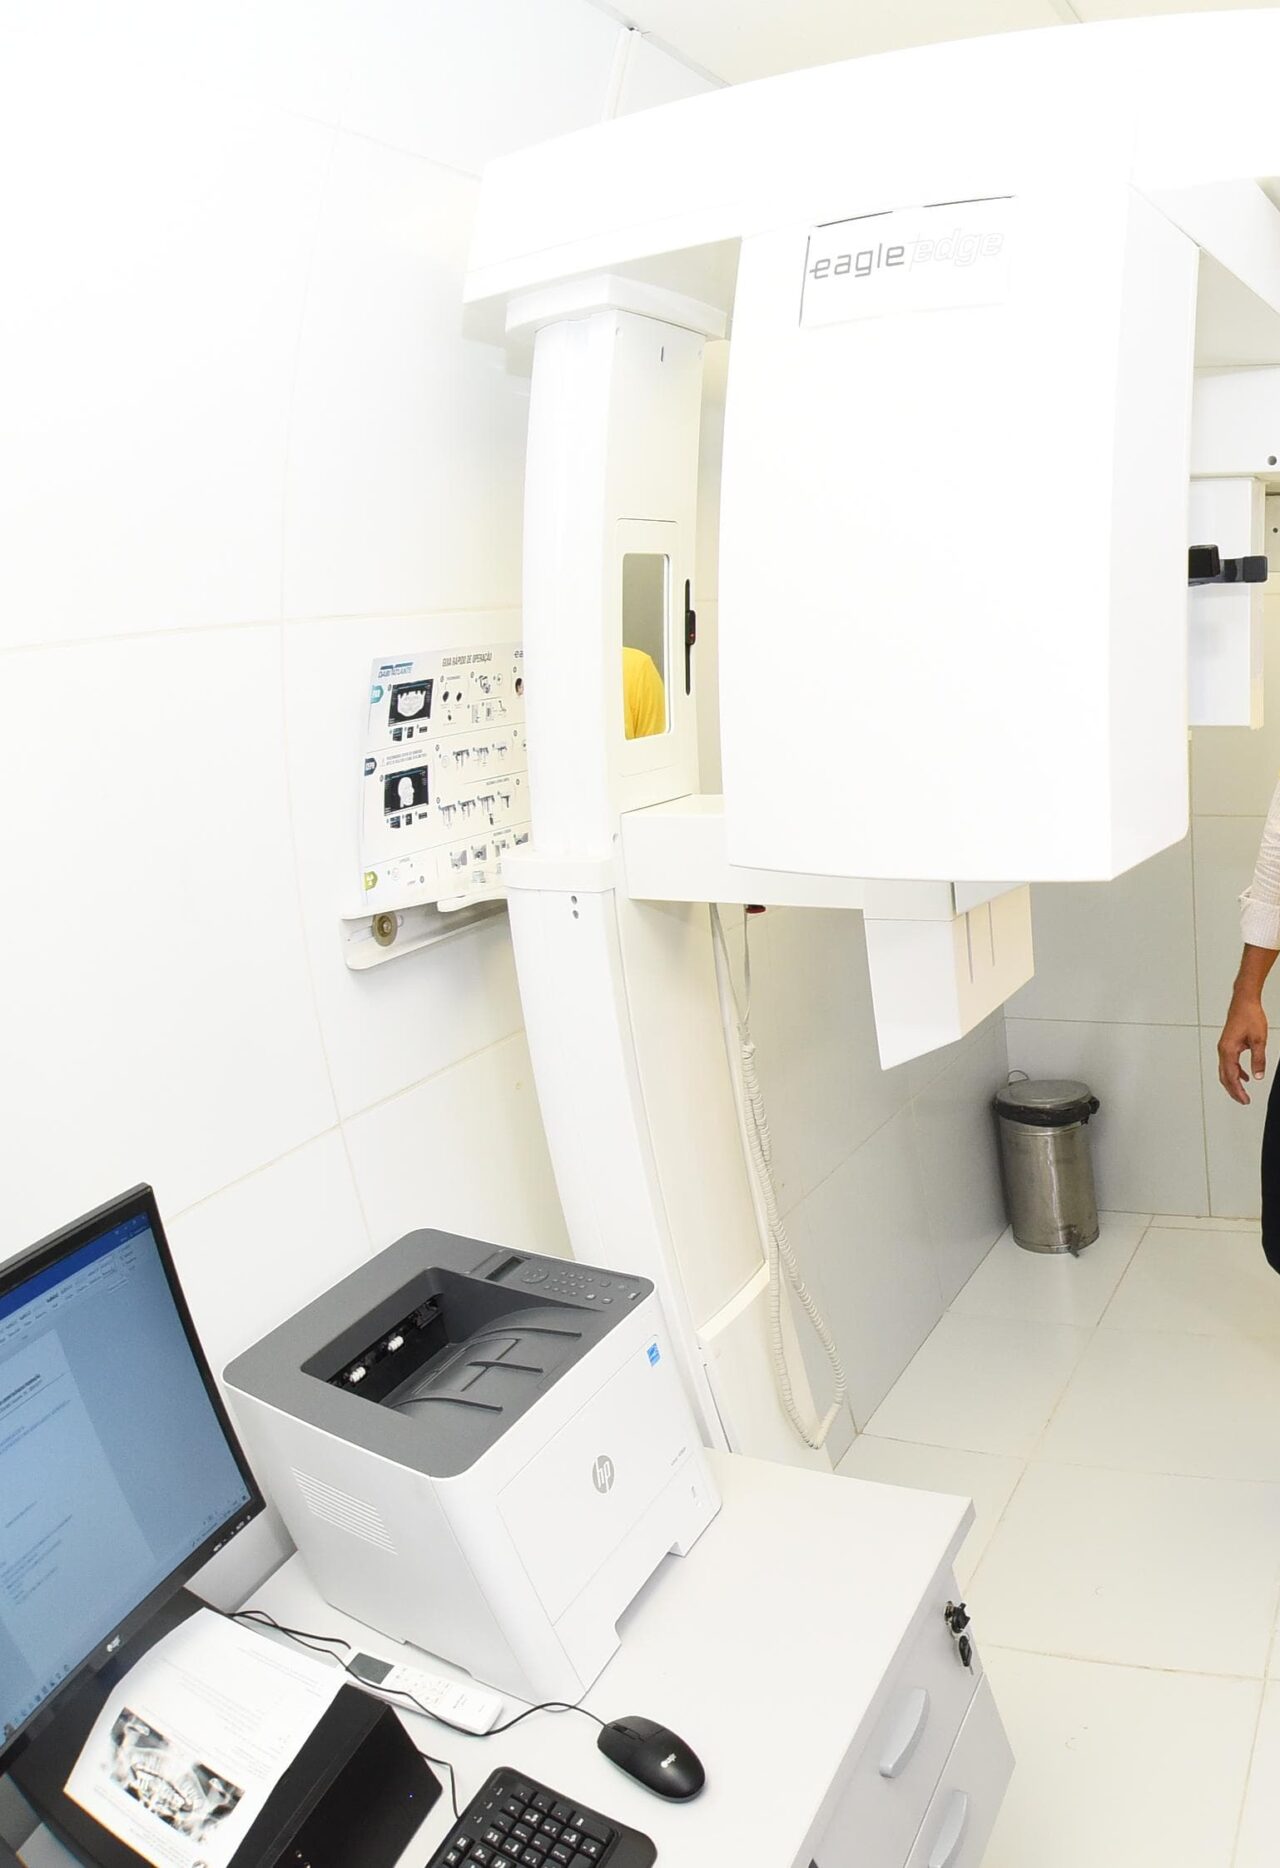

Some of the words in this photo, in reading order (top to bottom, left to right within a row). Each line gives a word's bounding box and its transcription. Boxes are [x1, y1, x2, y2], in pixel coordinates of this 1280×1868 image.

[809, 243, 905, 279] eagle
[911, 228, 1004, 267] edge
[593, 1454, 615, 1493] hp
